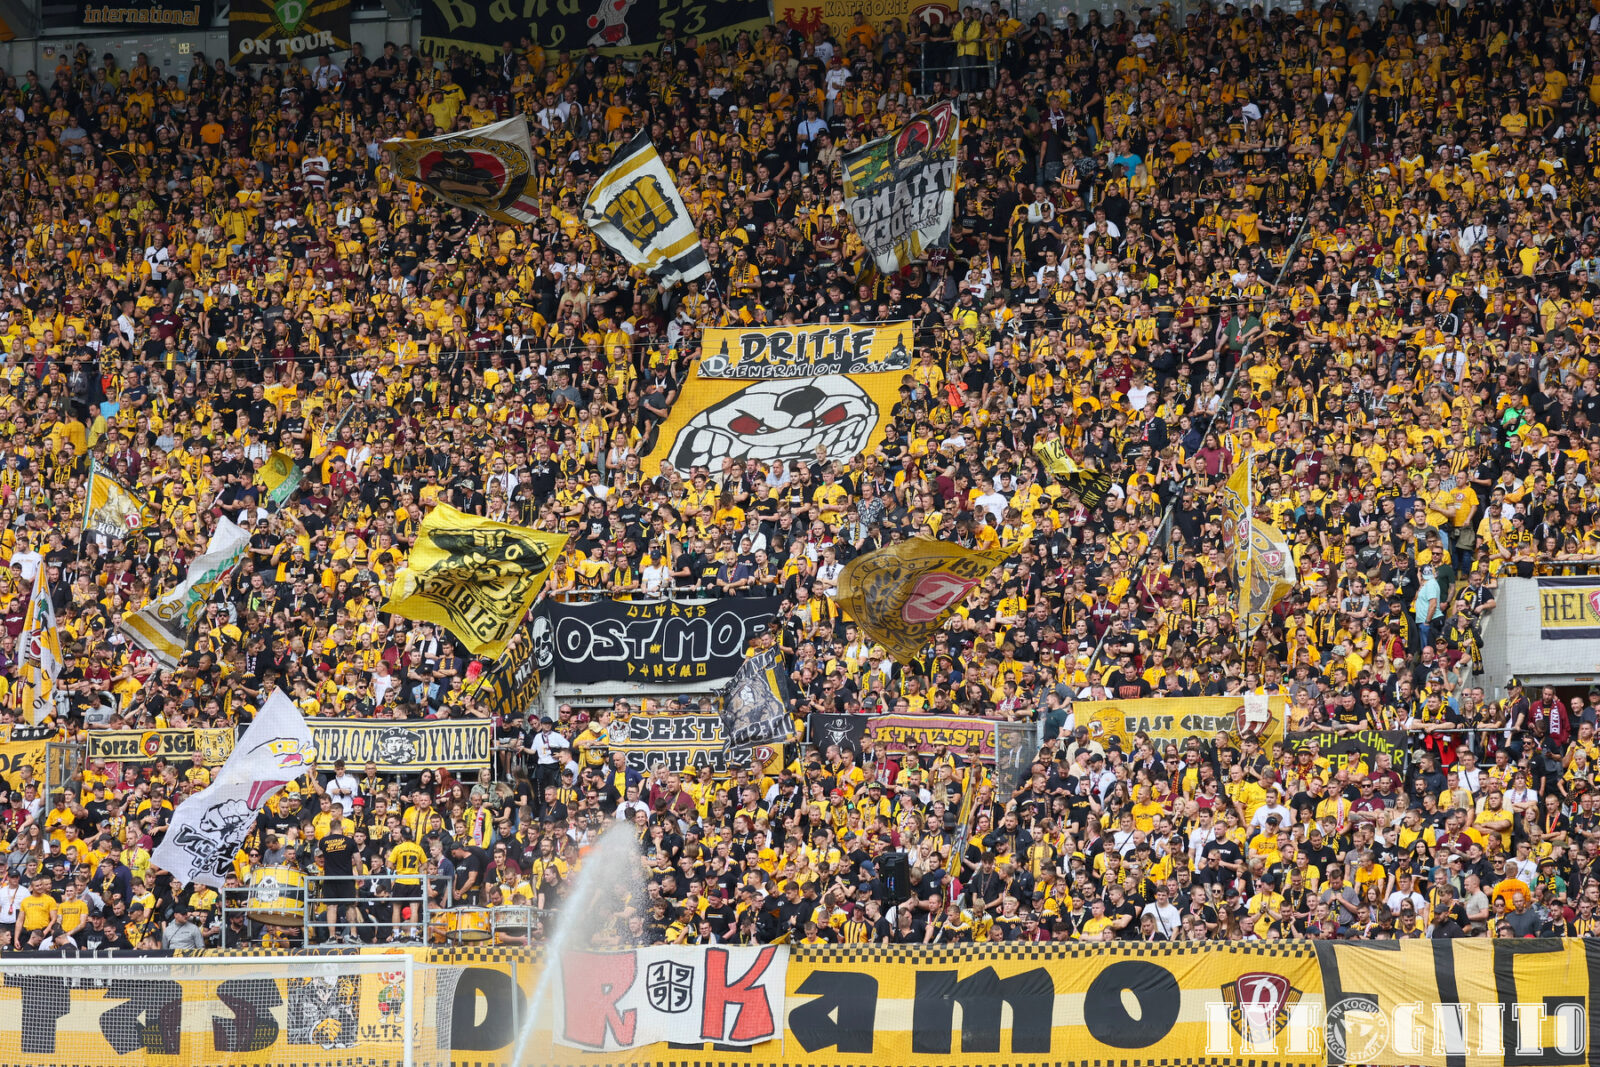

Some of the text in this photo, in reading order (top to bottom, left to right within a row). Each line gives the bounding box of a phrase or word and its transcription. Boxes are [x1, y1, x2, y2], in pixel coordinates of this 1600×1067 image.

[83, 4, 200, 26] international
[239, 30, 335, 55] ON TOUR
[739, 328, 875, 362] DRITTE
[723, 362, 841, 378] GENERATION
[1543, 593, 1586, 621] HEI
[1124, 714, 1236, 733] EAST CREW
[90, 737, 138, 756] Forza
[313, 726, 489, 763] STBLOCK DYNAMO
[402, 855, 417, 869] 12
[360, 1023, 420, 1040] ULTRS
